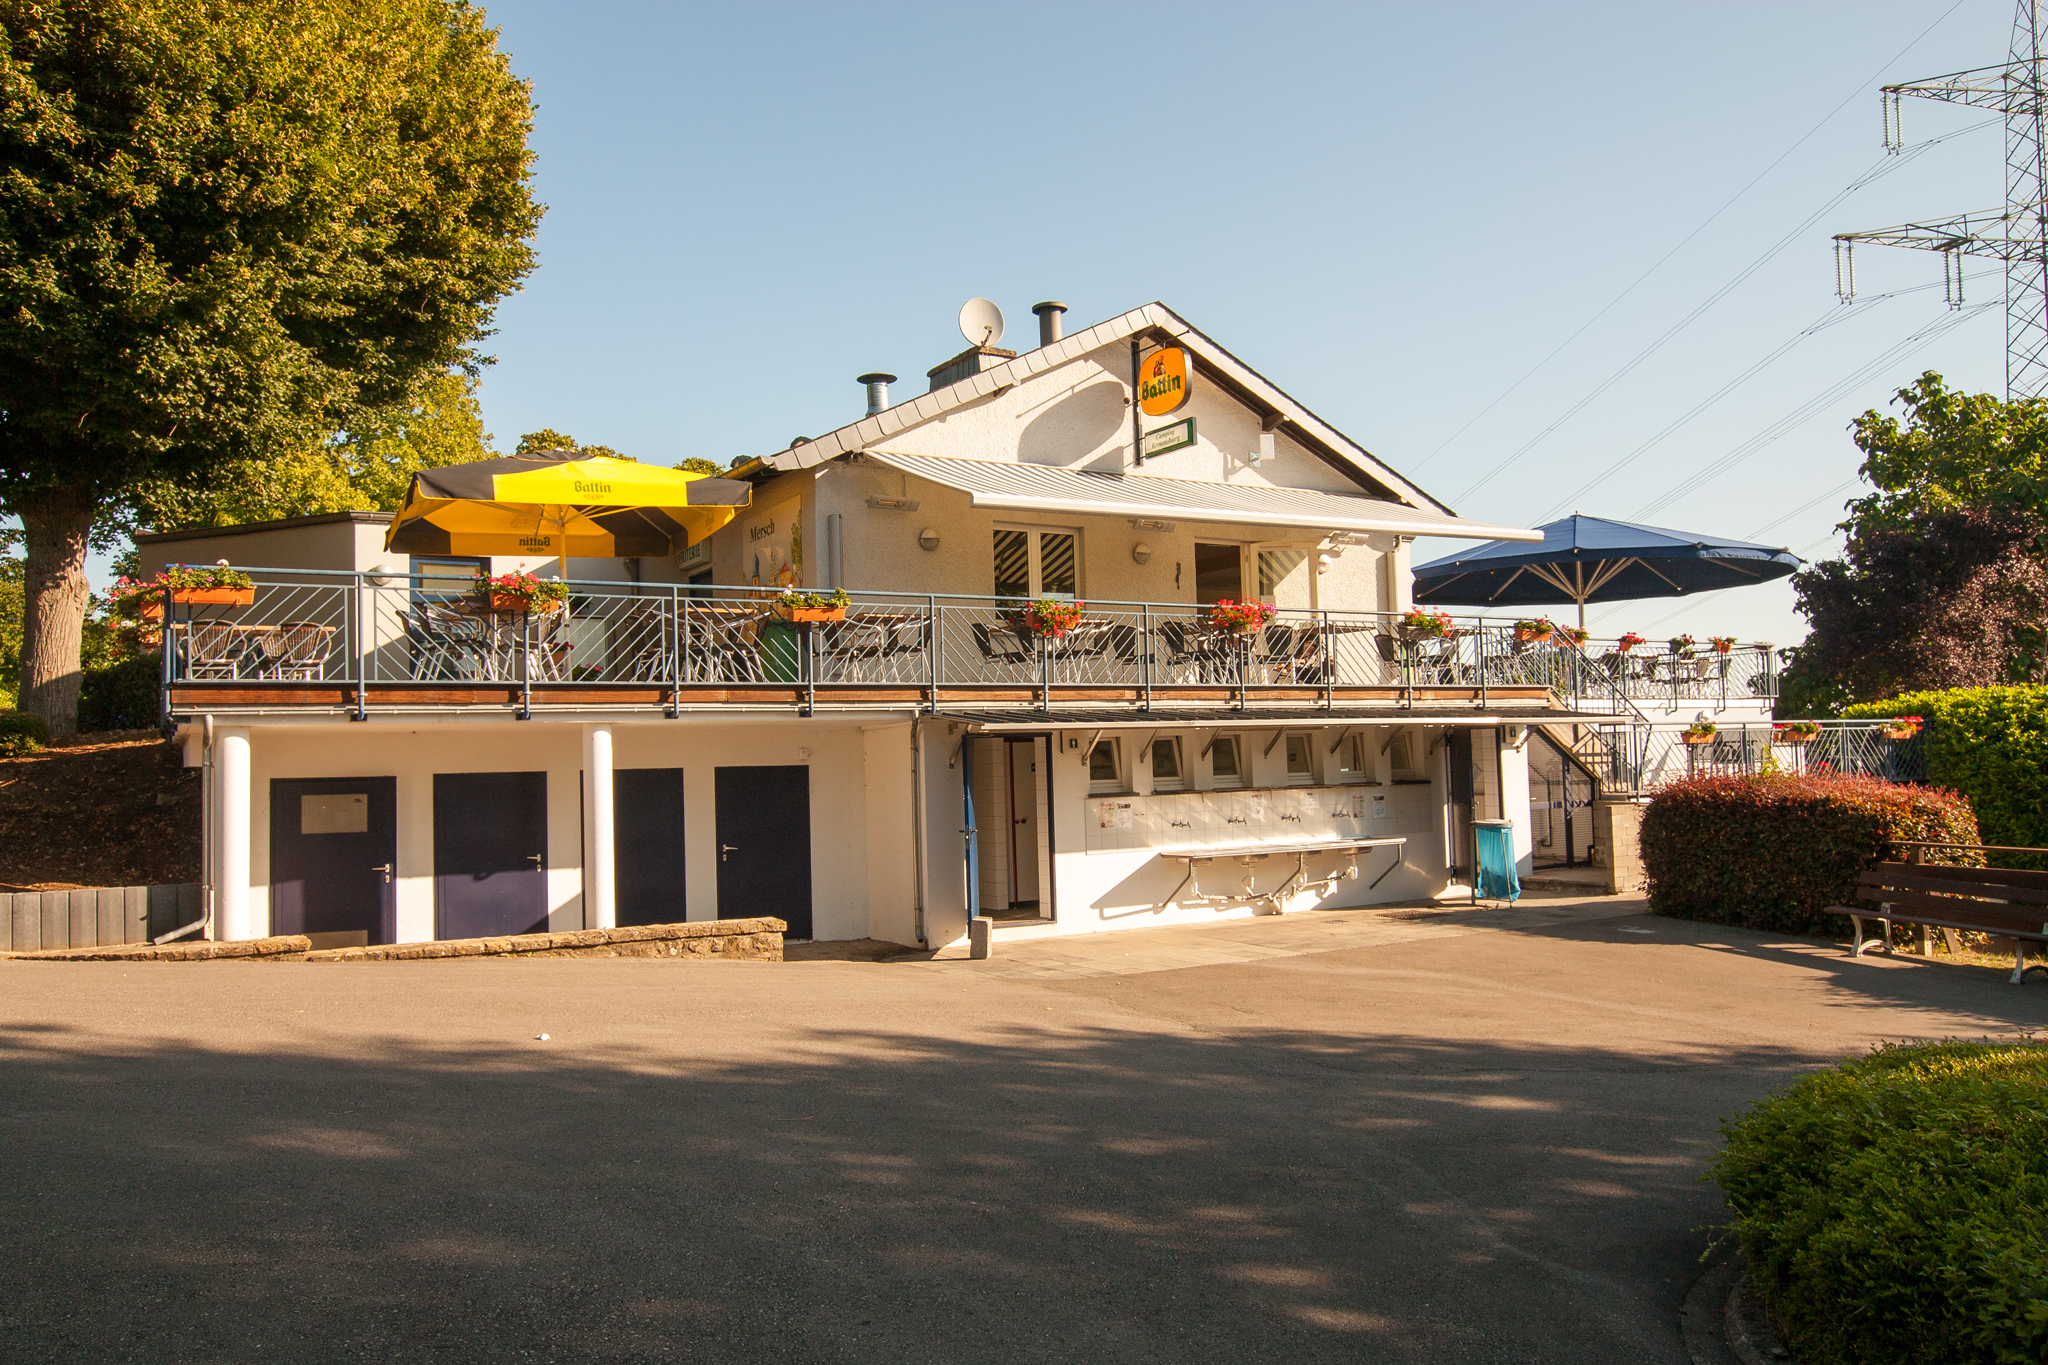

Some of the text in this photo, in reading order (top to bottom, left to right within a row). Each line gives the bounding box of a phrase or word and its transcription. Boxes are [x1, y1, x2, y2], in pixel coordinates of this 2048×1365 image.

[1142, 374, 1181, 401] Battin
[1155, 429, 1176, 440] Camping
[574, 480, 612, 493] Battin
[750, 518, 775, 543] Mersch
